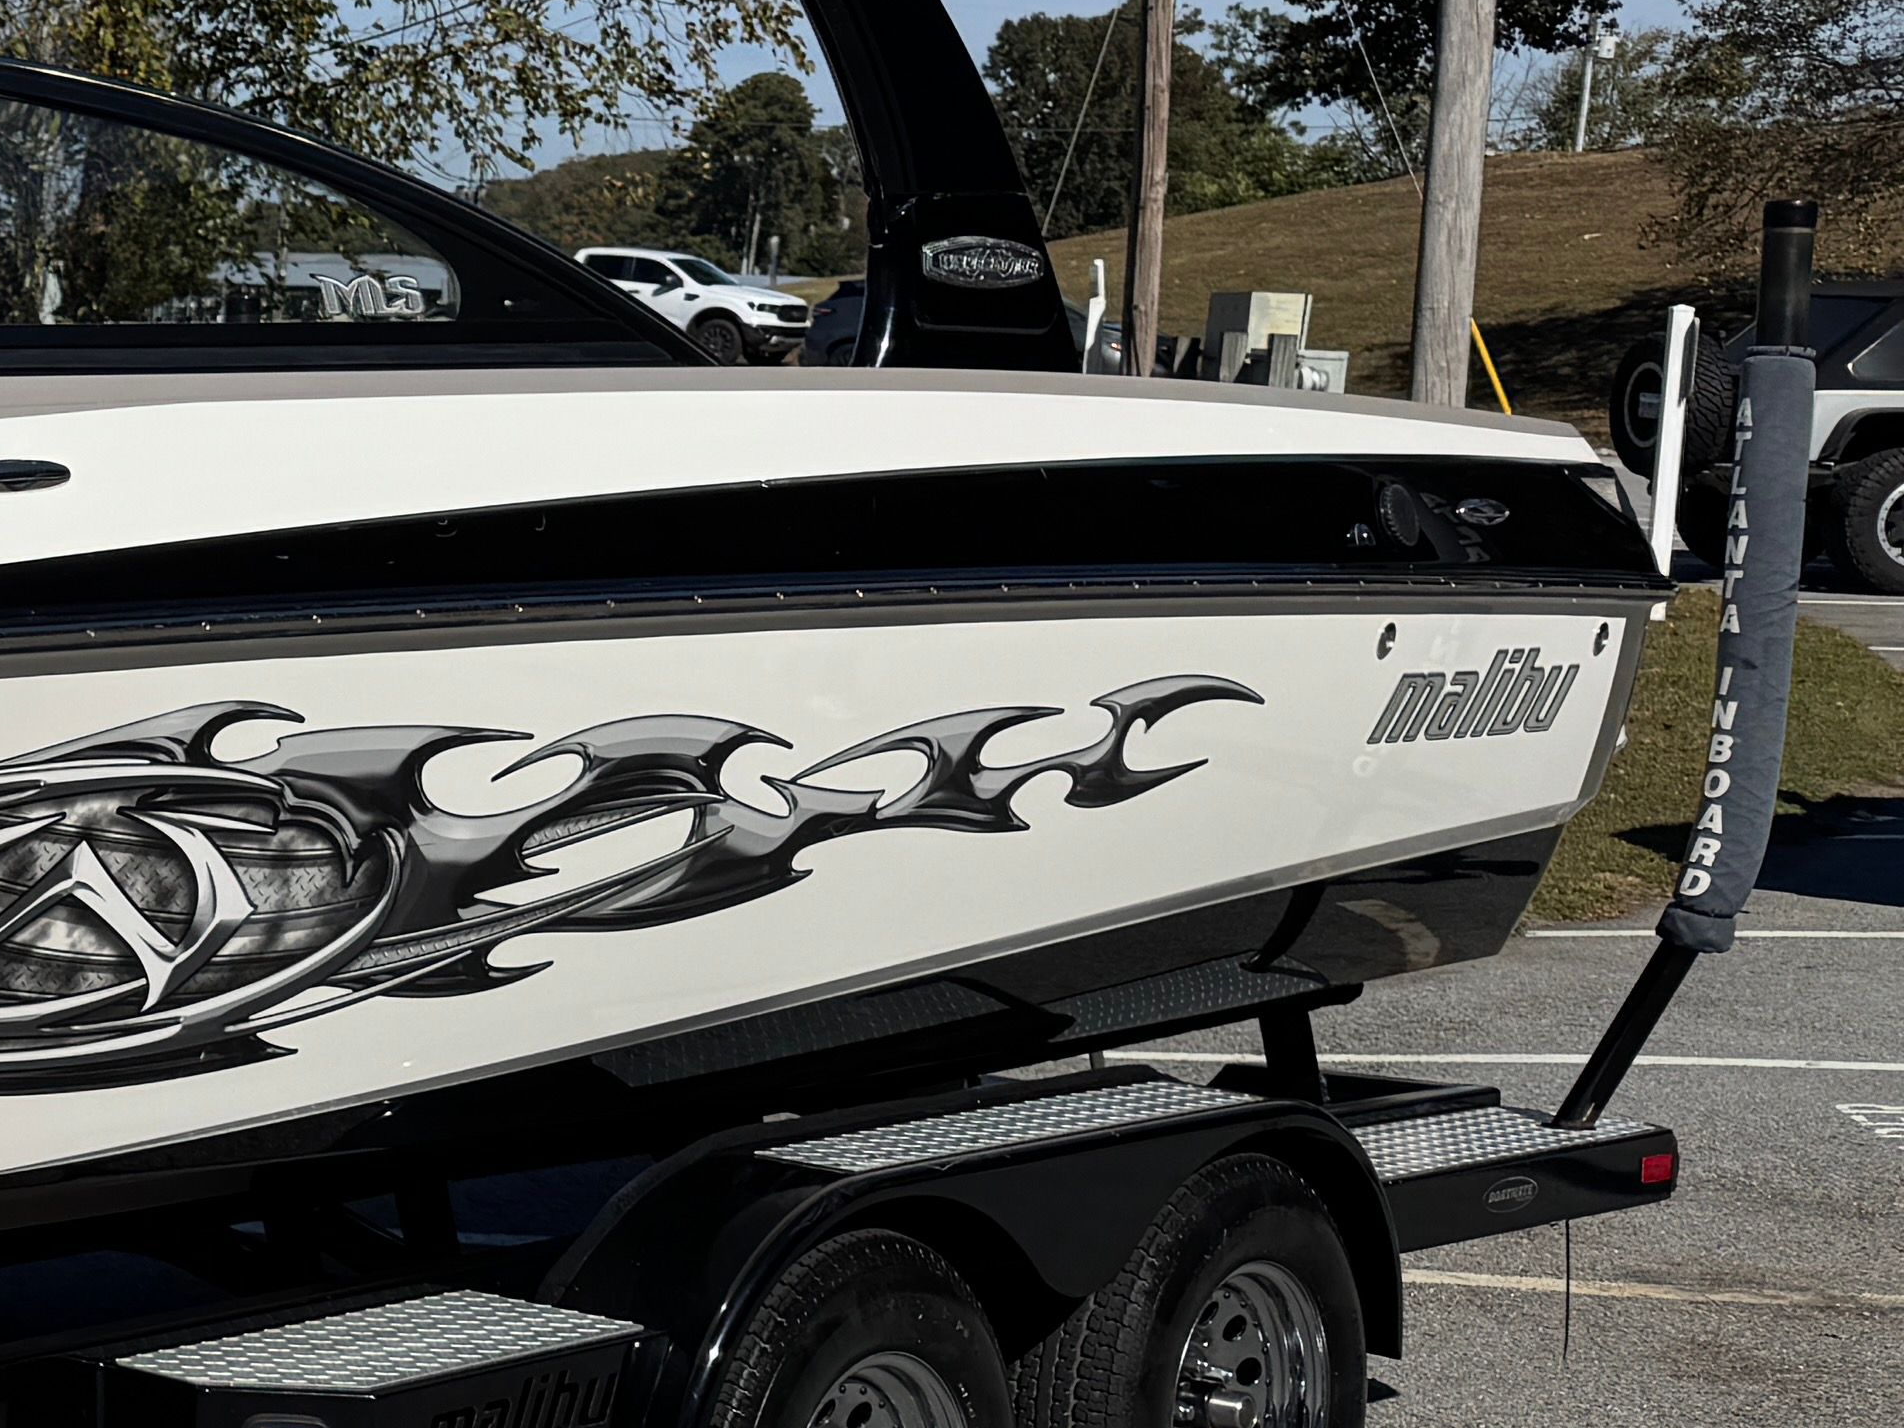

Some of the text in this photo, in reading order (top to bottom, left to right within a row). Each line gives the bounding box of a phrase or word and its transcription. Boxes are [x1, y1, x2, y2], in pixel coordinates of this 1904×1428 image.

[1366, 647, 1580, 745] malibu
[1679, 397, 1753, 897] ATLANTA INBOARD
